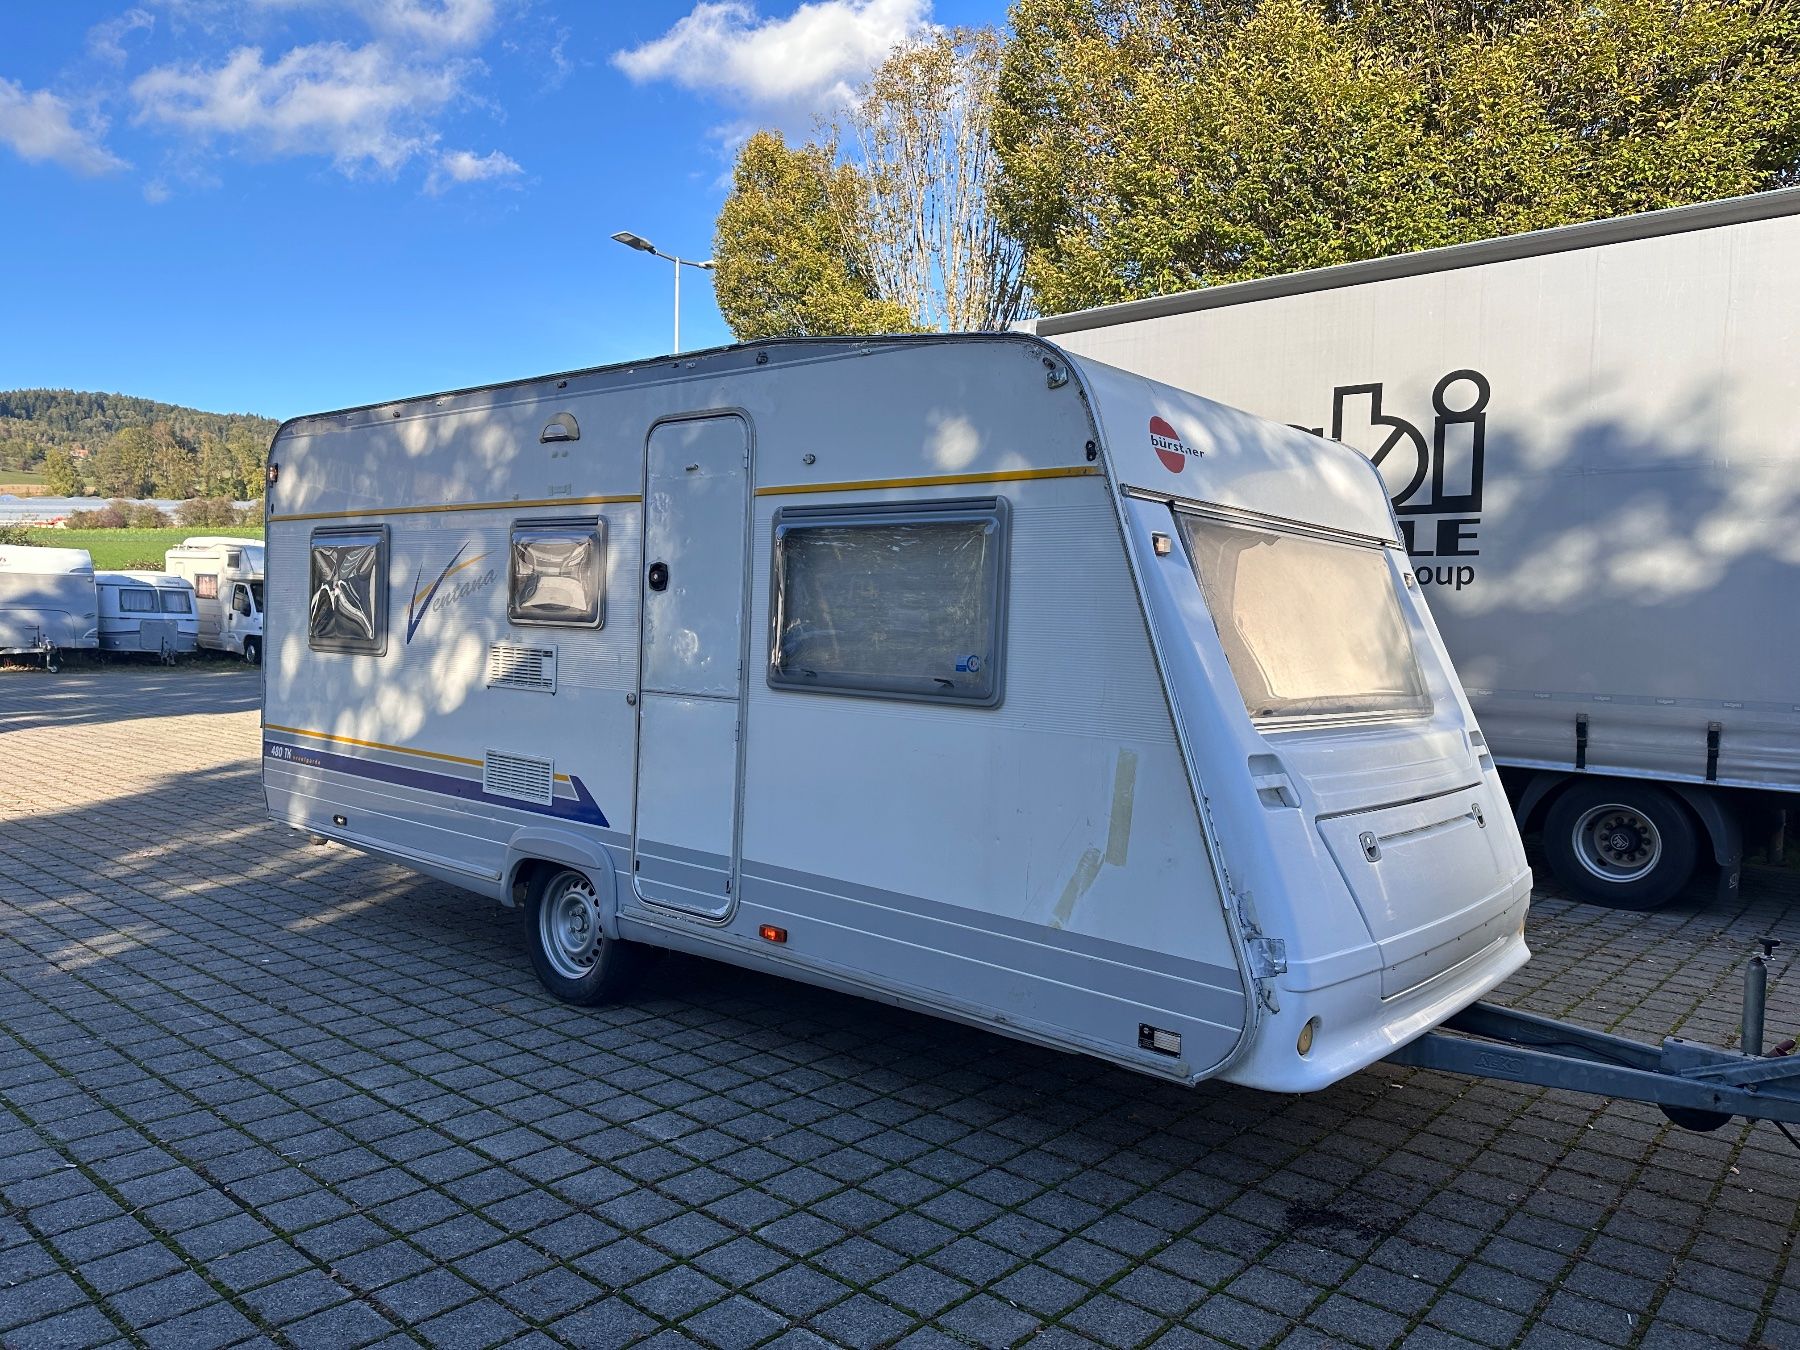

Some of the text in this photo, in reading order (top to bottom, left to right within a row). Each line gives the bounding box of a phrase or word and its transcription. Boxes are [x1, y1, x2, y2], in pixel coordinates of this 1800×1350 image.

[1150, 434, 1205, 458] bürstner
[1412, 565, 1475, 591] oup
[271, 745, 283, 758] 480
